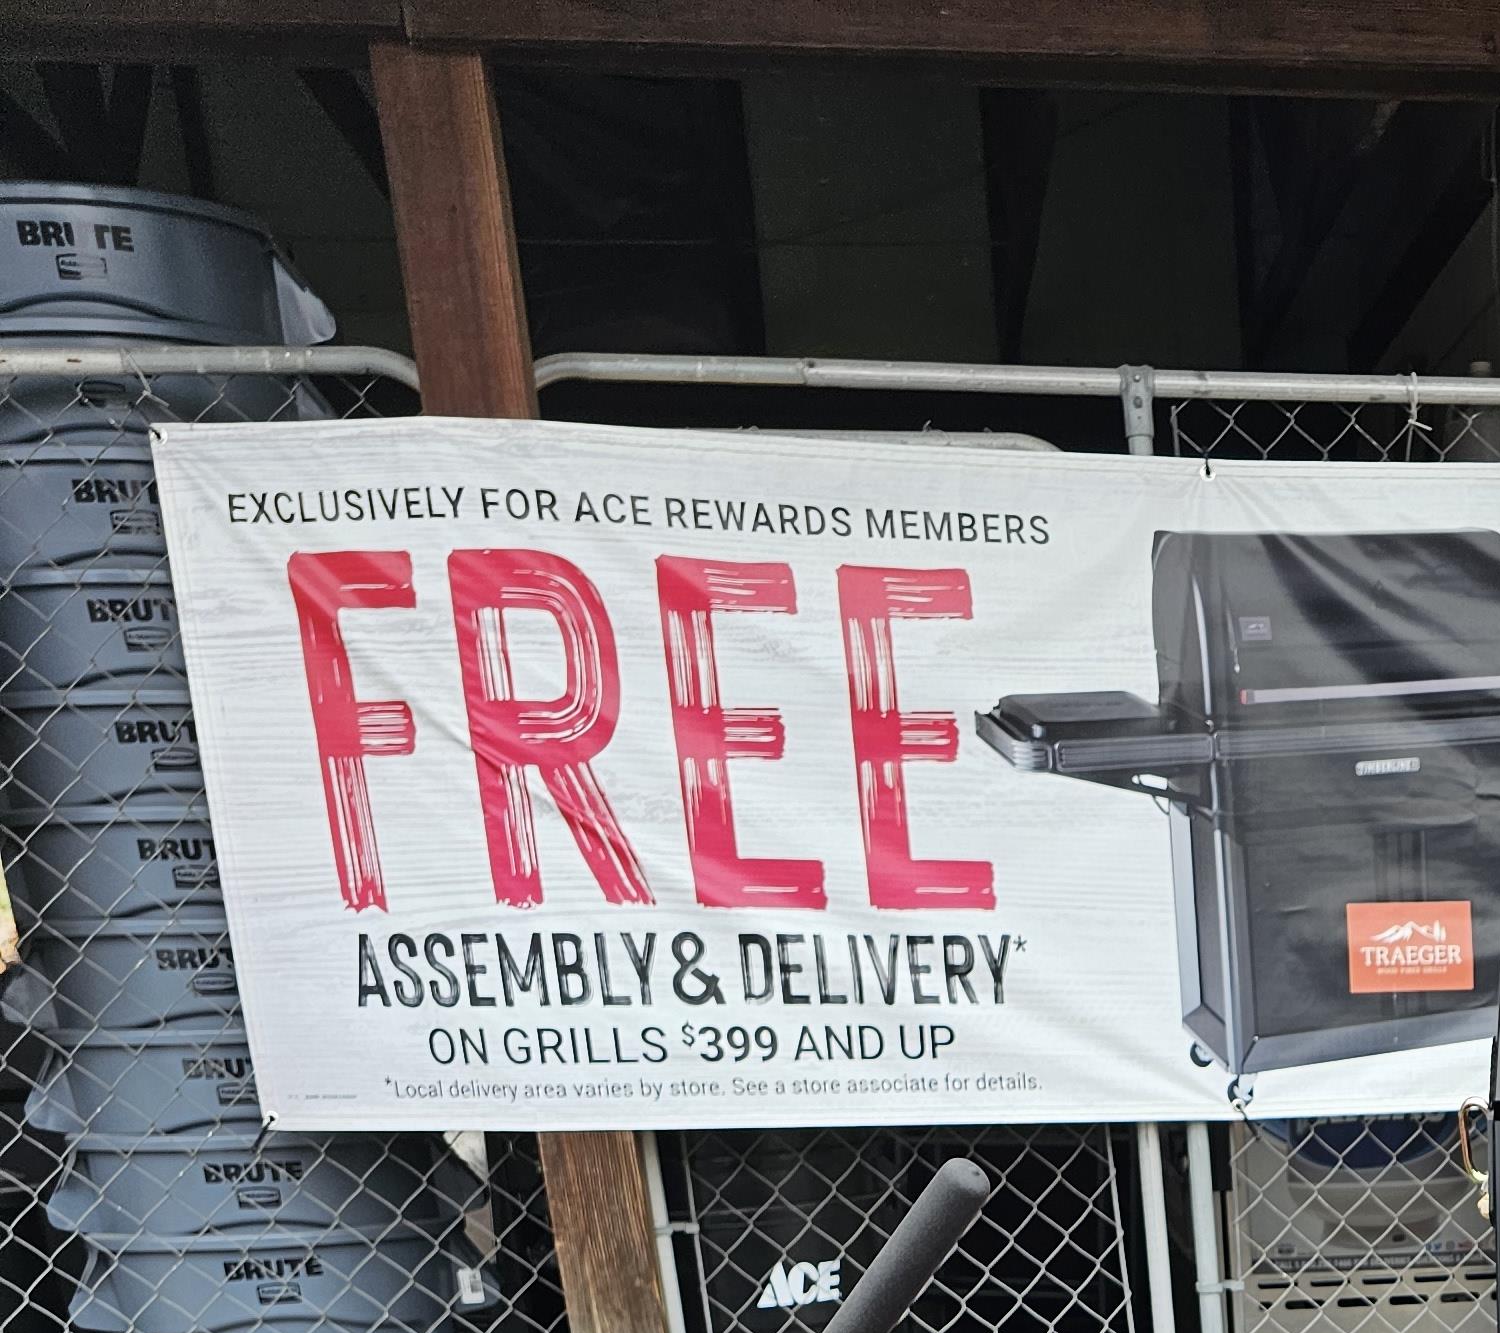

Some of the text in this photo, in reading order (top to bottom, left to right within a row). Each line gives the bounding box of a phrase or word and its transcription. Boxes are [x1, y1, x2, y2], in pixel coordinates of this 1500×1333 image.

[72, 479, 159, 504] BRUT
[228, 487, 1051, 545] EXCLUSIVELY FOR ACE REWARDS MEMBERS
[86, 598, 175, 623] BRUT
[115, 720, 199, 743] BRUT
[287, 548, 997, 914] FREE
[137, 838, 216, 861] BRUT
[156, 948, 234, 970] BRUT
[1361, 944, 1463, 967] TRAEGER
[358, 932, 657, 1008] ASSEMBLY
[671, 931, 727, 1005] &
[429, 1020, 955, 1064] ON GRILLS $399 AND UP
[182, 1058, 252, 1079] BRU
[450, 1079, 518, 1104] delivery
[524, 1082, 567, 1098] area
[573, 1079, 634, 1098] varies
[640, 1078, 663, 1101] by
[670, 1079, 726, 1097] store.
[732, 1077, 769, 1096] See
[775, 1080, 786, 1095] a
[792, 1078, 840, 1095] store
[847, 1074, 939, 1094] associate
[944, 1072, 970, 1092] for
[976, 1072, 1042, 1092] details.
[203, 1161, 302, 1183] BRUTE
[224, 1256, 324, 1281] BRUTE
[757, 1260, 841, 1308] ACE
